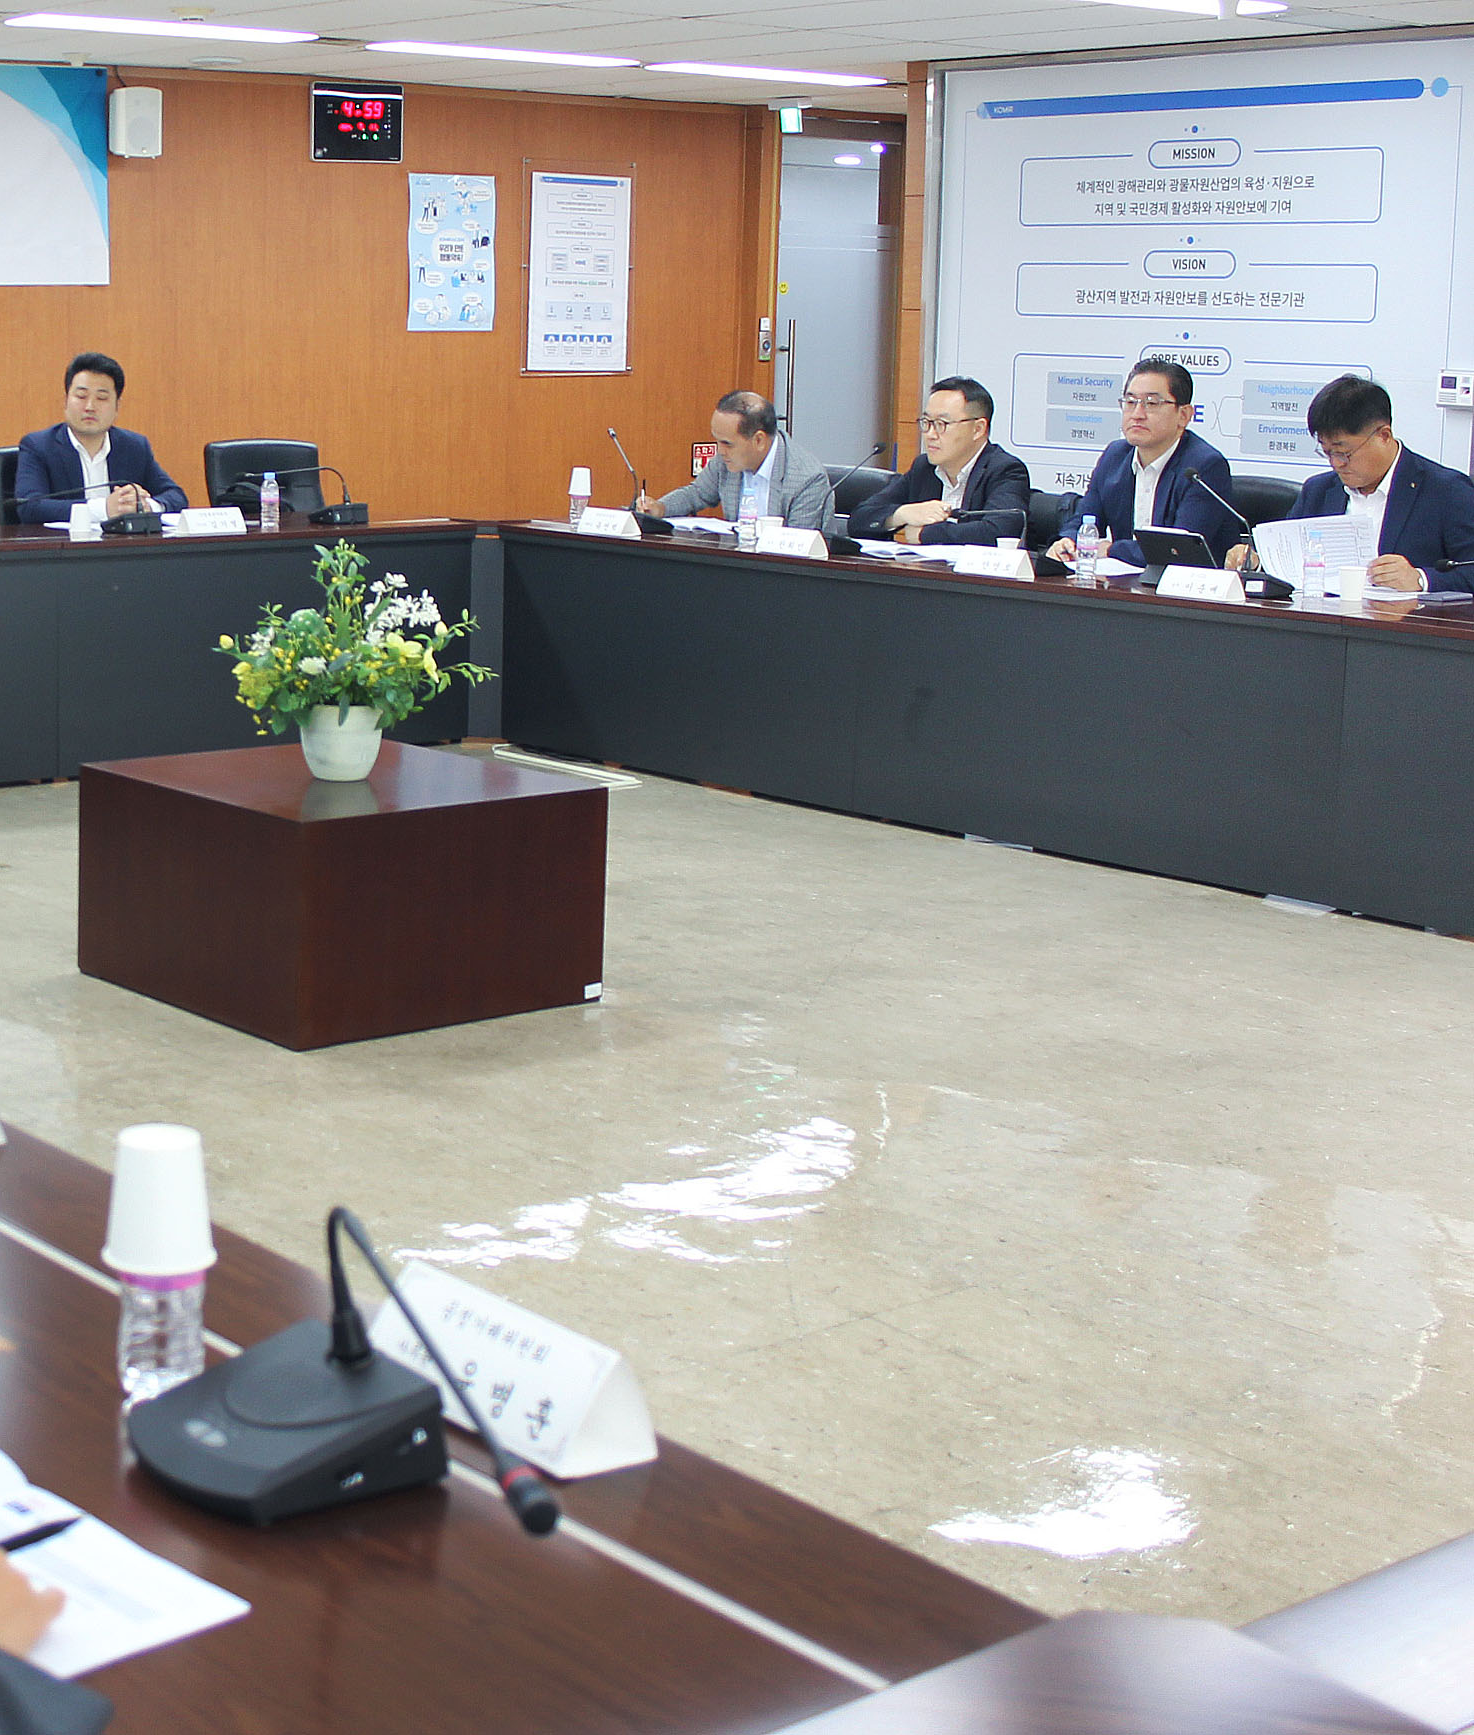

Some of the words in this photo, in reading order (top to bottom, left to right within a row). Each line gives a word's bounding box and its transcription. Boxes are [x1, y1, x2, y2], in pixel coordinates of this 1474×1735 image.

[1172, 148, 1216, 160] MISSION
[1076, 180, 1114, 194] 체계적인
[1117, 178, 1166, 193] 광해관리와
[1169, 177, 1241, 192] 광물자원산업의
[1094, 203, 1113, 216] 지역
[1117, 202, 1126, 216] 및
[1129, 202, 1169, 216] 국민경제
[1171, 200, 1212, 215] 활성화와
[1215, 200, 1267, 215] 자원안보에
[1270, 200, 1292, 214] 기여
[1172, 258, 1206, 270] VISION
[1075, 289, 1116, 304] 광산지역
[1119, 290, 1151, 305] 발전과
[1154, 290, 1208, 306] 자원안보를
[1211, 291, 1256, 307] 선도하는
[1259, 292, 1305, 308] 전문기관
[1179, 354, 1220, 366] VALUES
[1057, 376, 1083, 386] Mineral
[1085, 376, 1113, 388] Security
[1258, 384, 1314, 396] Neighborhood
[1270, 401, 1299, 412] 지역발전
[1258, 423, 1309, 436] Environment
